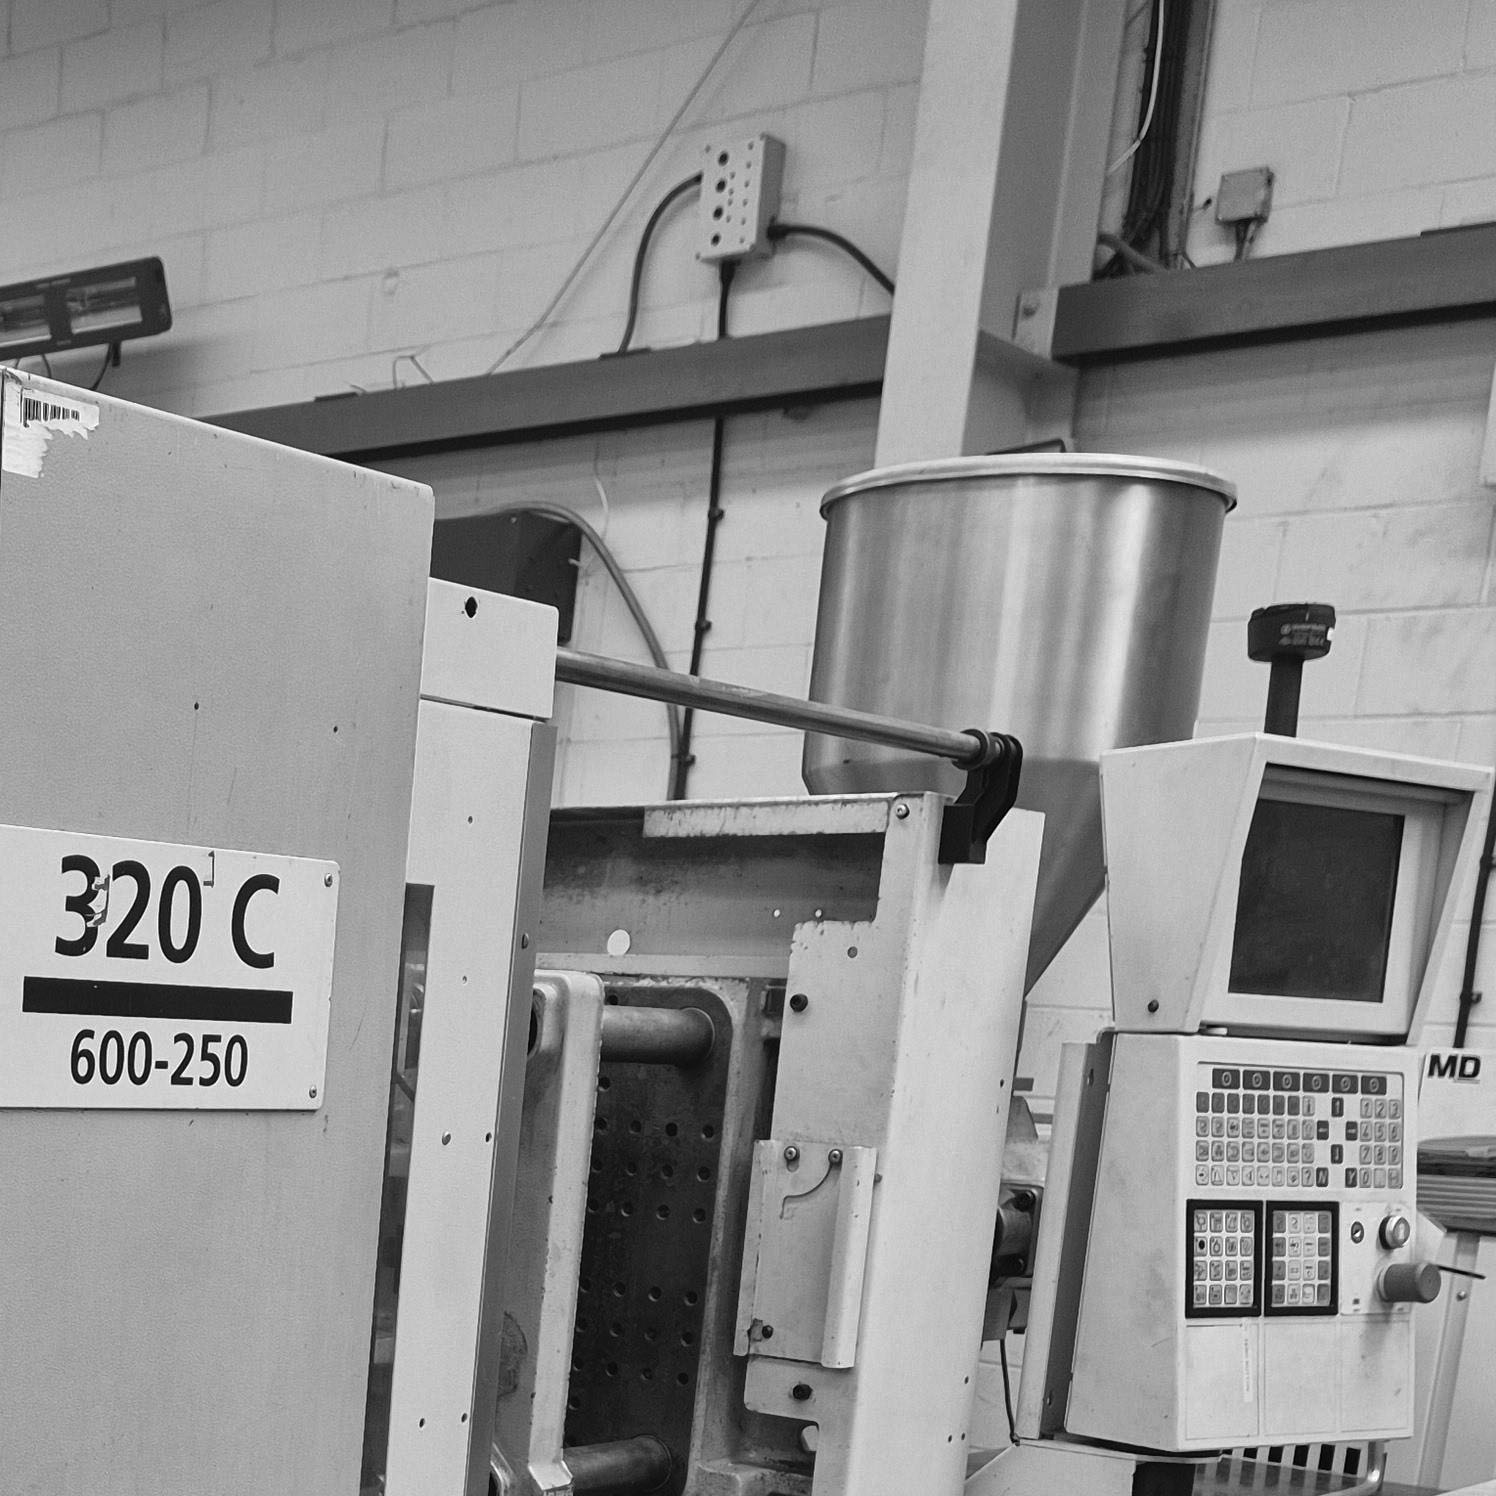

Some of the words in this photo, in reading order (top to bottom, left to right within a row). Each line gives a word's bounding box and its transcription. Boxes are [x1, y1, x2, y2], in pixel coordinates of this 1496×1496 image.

[55, 853, 204, 965] 320
[231, 873, 281, 970] C
[70, 1030, 250, 1088] 600-250
[1427, 1053, 1482, 1079] MD
